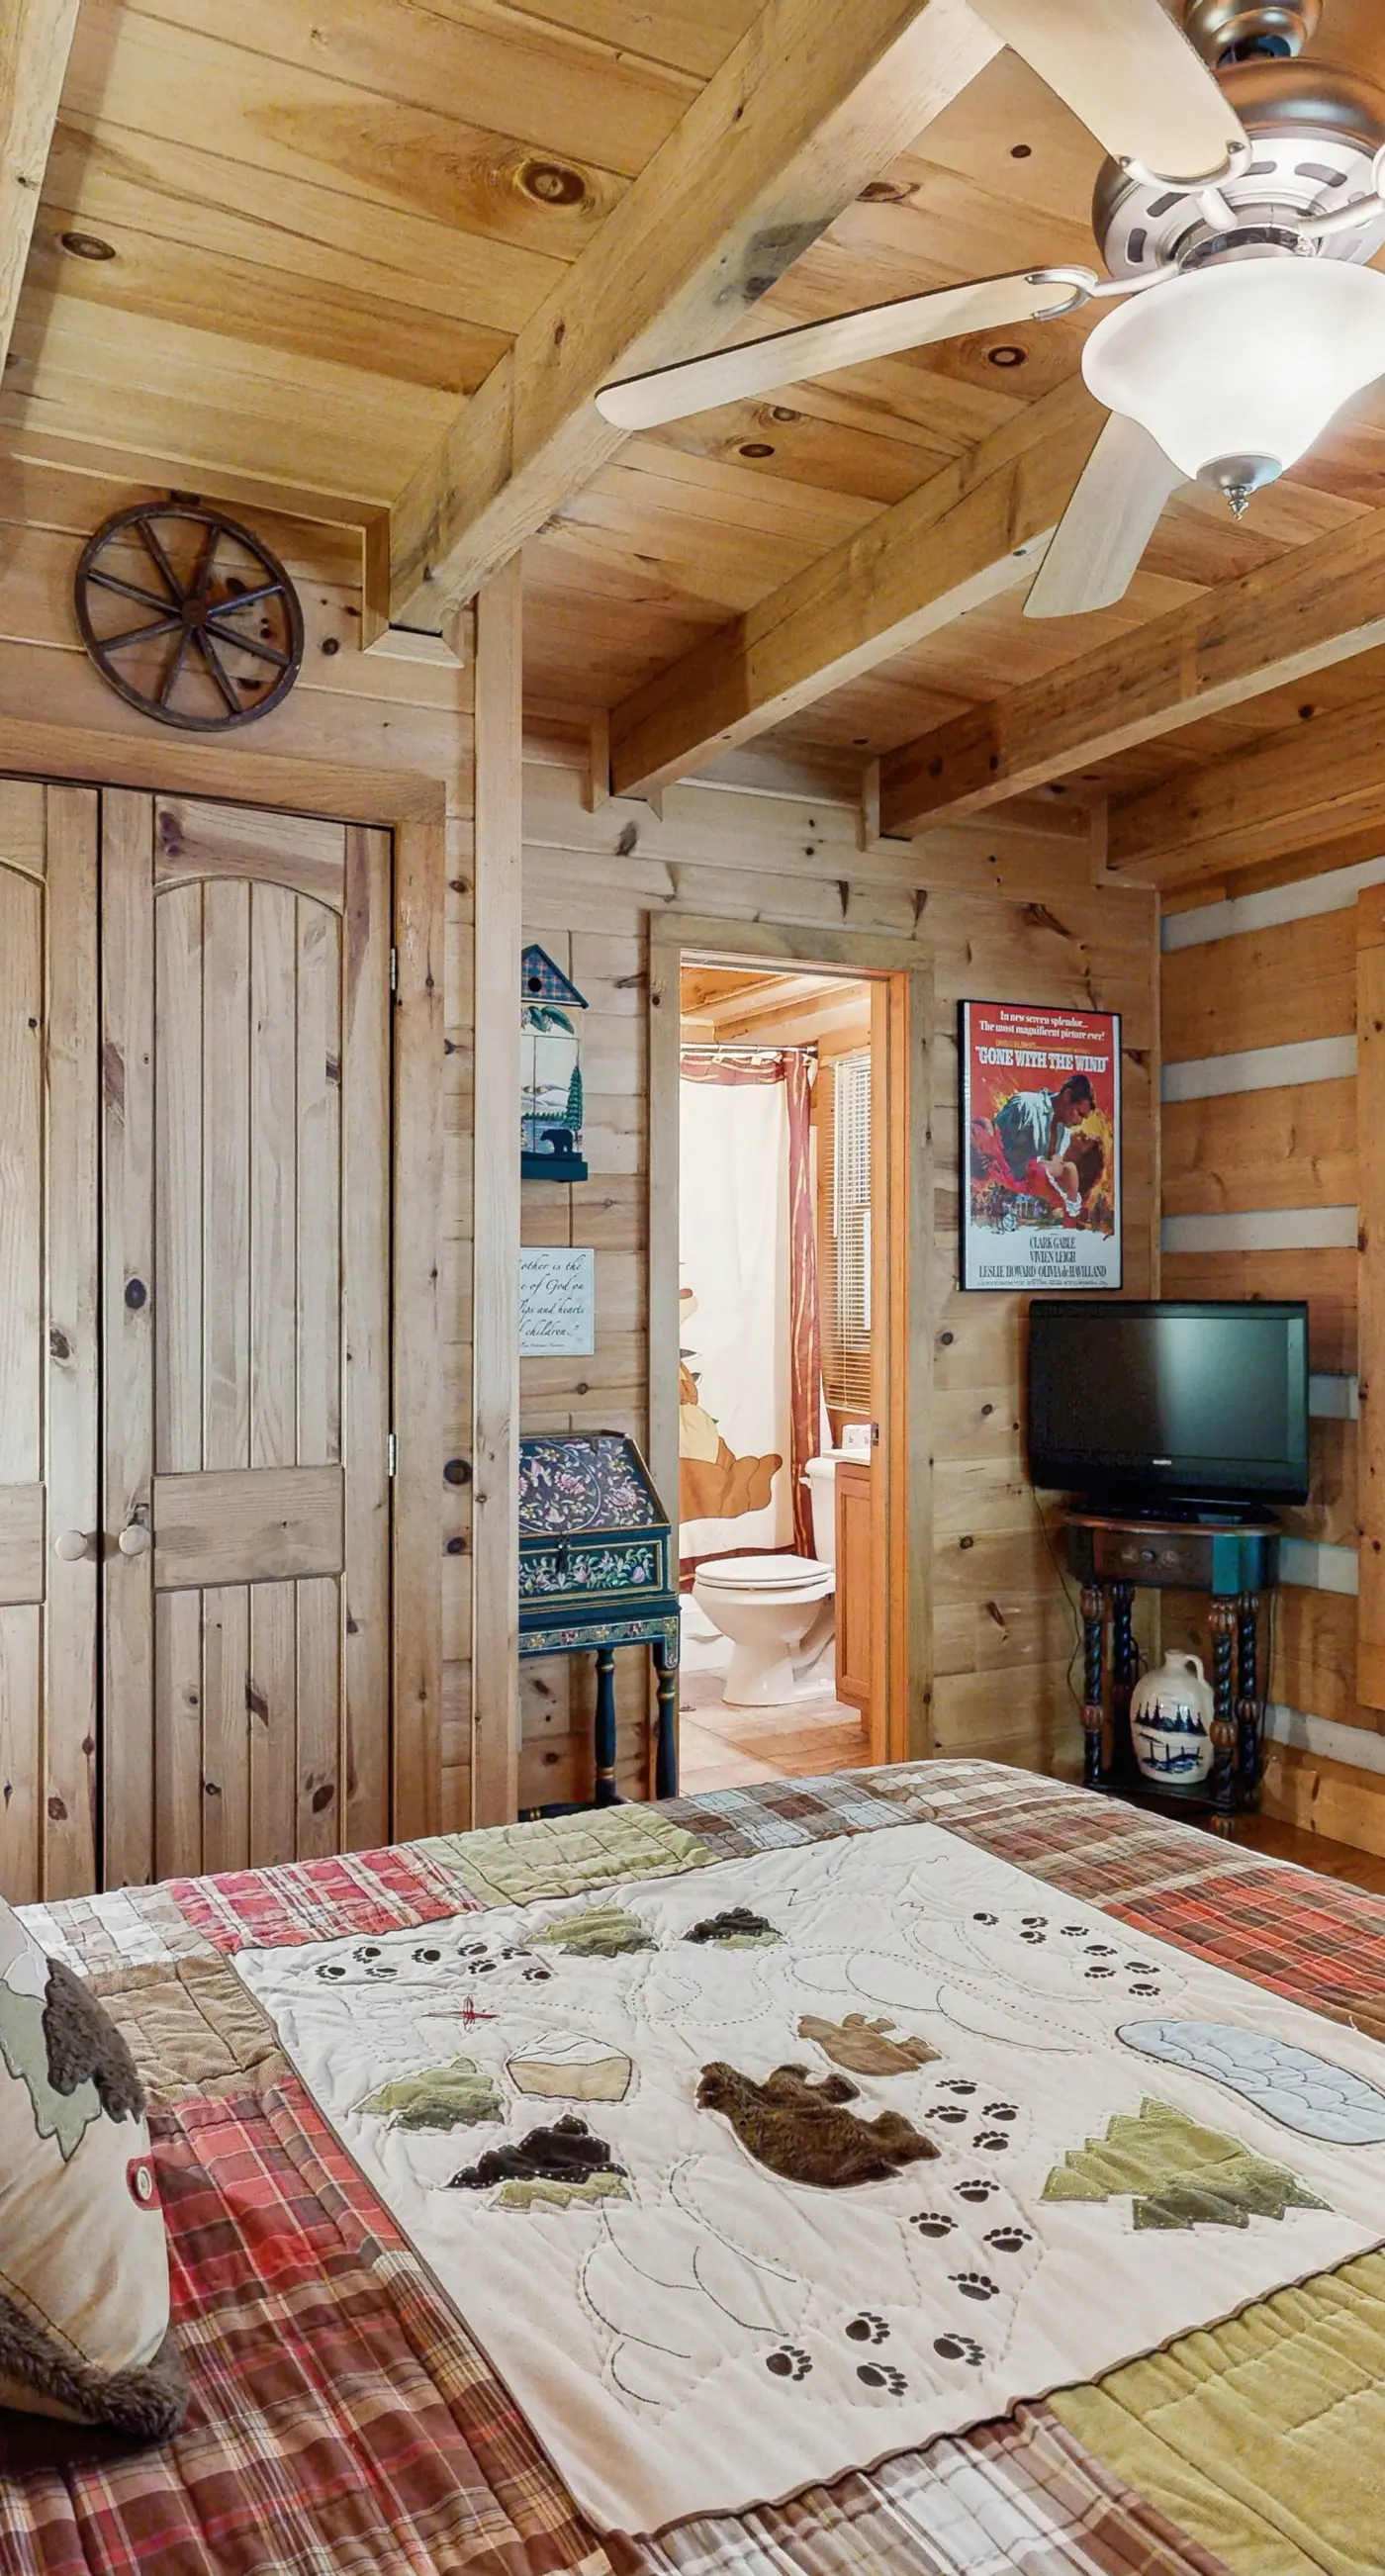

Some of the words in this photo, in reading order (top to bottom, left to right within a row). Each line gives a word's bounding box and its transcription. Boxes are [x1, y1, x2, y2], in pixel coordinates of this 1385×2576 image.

[1000, 1010, 1009, 1021] In
[1025, 1015, 1050, 1025] screen
[979, 1020, 995, 1032] The
[995, 1024, 1015, 1034] most
[1015, 1025, 1060, 1037] magnificent
[1061, 1028, 1086, 1040] picture
[1086, 1031, 1105, 1041] ever!
[1014, 1049, 1048, 1068] WITH
[1049, 1052, 1073, 1070] THE
[1029, 1237, 1053, 1249] CLARK
[1054, 1237, 1076, 1249] GABLE
[519, 1253, 549, 1271] other
[552, 1261, 561, 1270] is
[565, 1253, 587, 1271] the
[1029, 1250, 1054, 1263] VIVIEN
[1055, 1250, 1076, 1263] LEIGH
[979, 1265, 1005, 1278] LESLIE
[1006, 1265, 1037, 1278] HOWARD
[1038, 1265, 1062, 1278] OLIVIA
[1068, 1265, 1107, 1278] HAVILLAND
[529, 1273, 550, 1296] of
[545, 1273, 580, 1295] God
[557, 1297, 585, 1315] hearts
